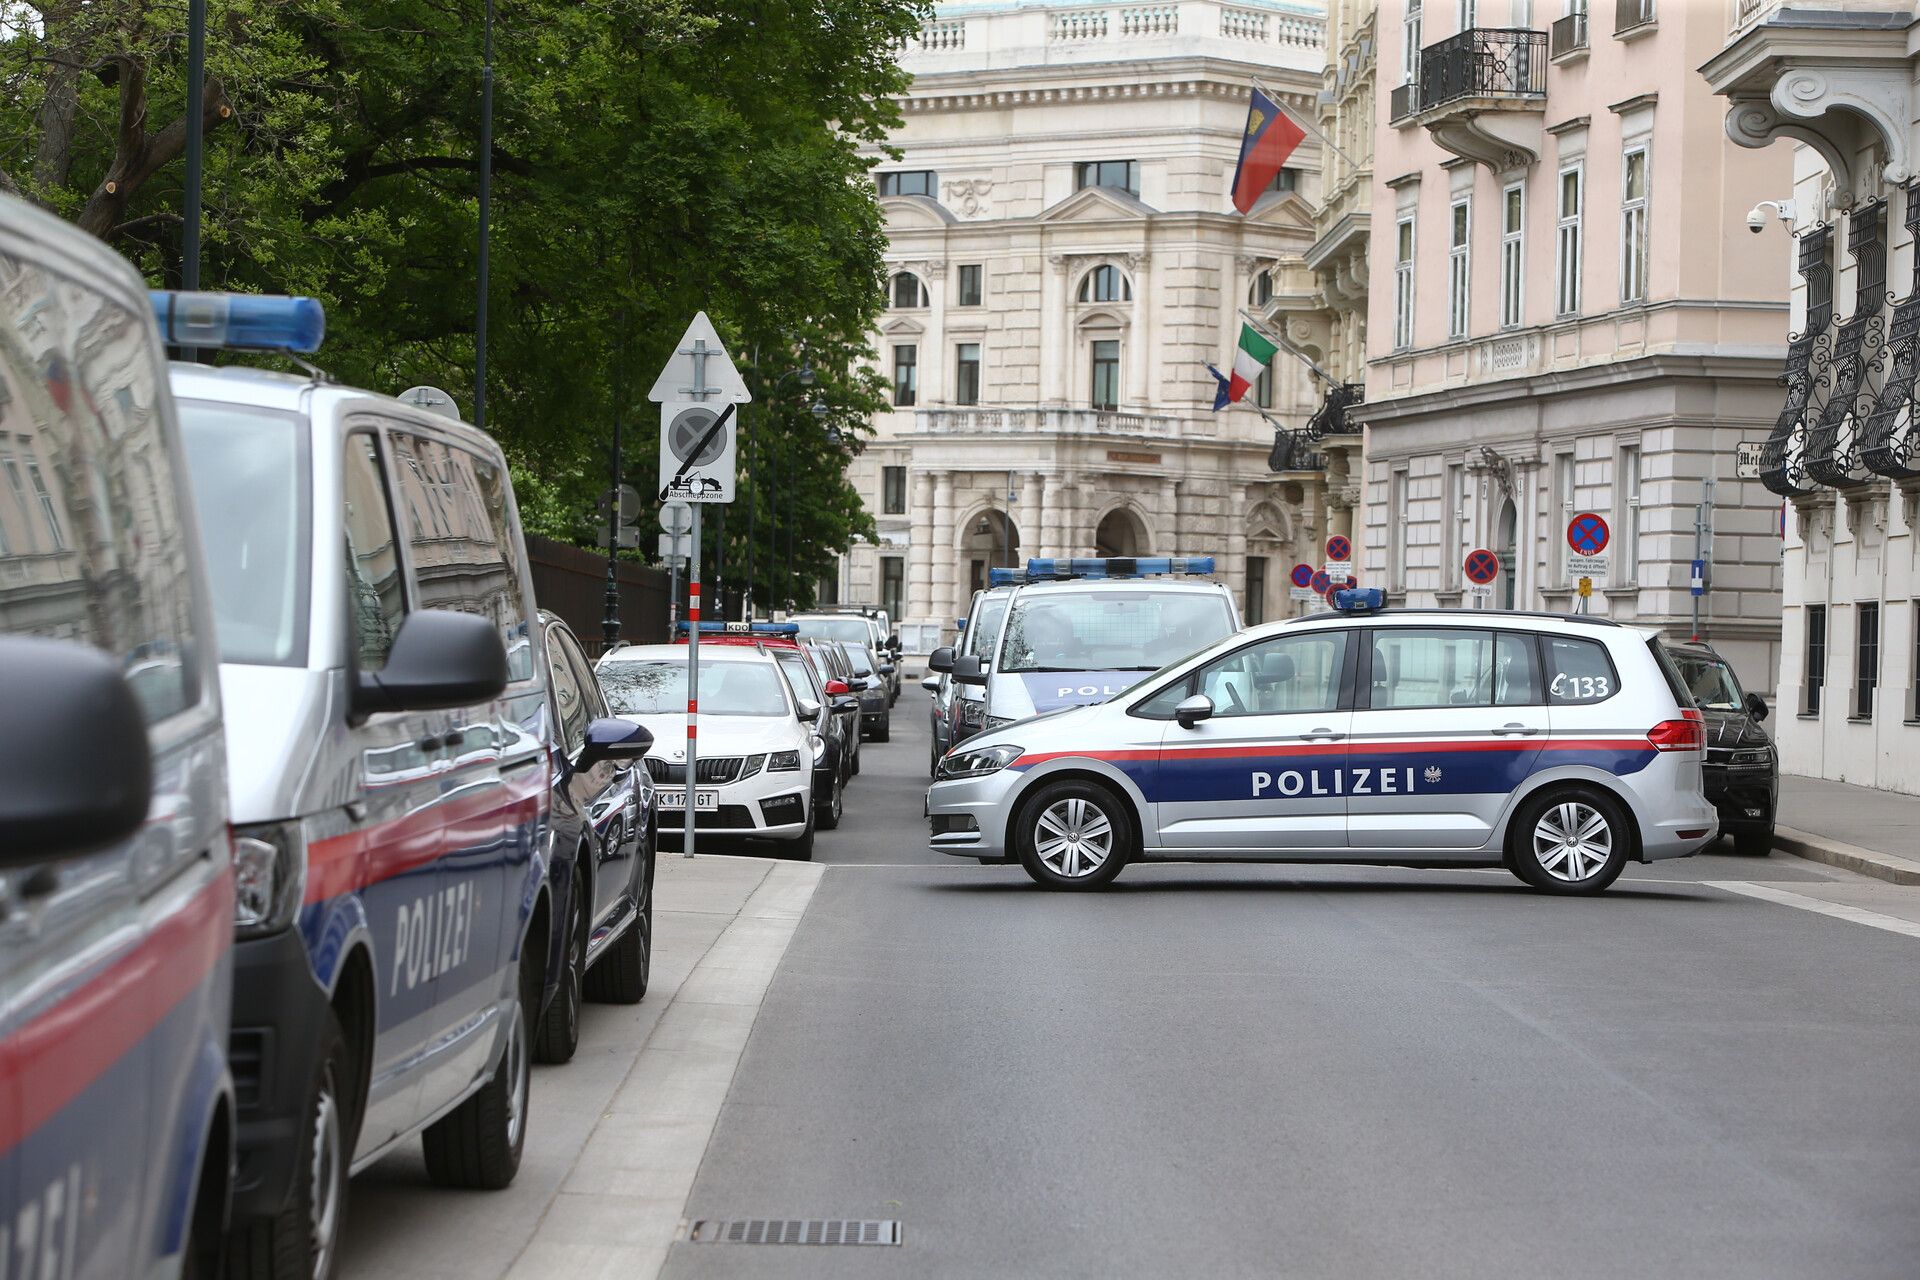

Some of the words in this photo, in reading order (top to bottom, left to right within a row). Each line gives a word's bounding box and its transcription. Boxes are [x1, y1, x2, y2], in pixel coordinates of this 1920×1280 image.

[728, 624, 749, 632] KDO
[1569, 677, 1609, 698] 133
[1252, 767, 1415, 797] POLIZEI
[697, 794, 712, 806] GT
[390, 880, 474, 998] POLIZEI
